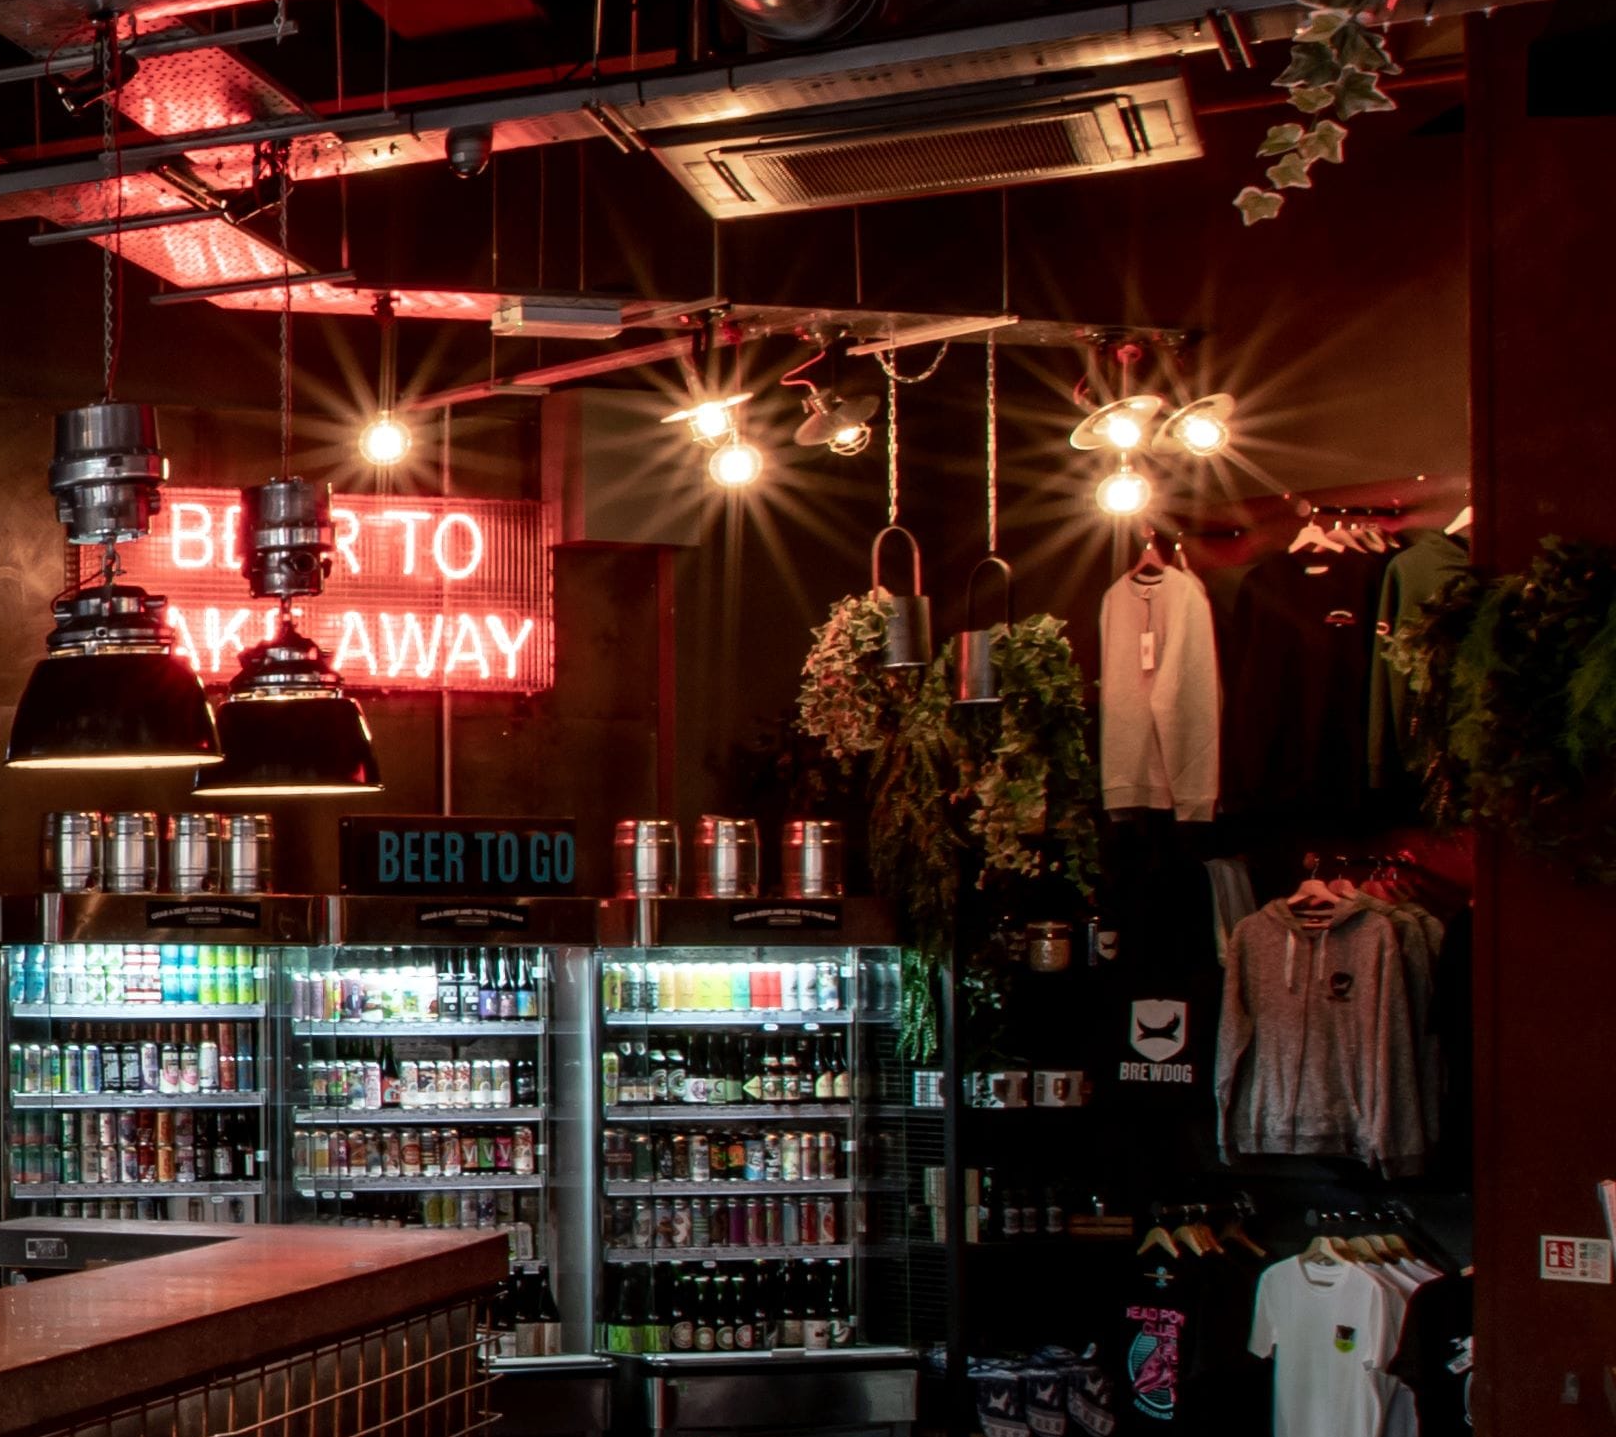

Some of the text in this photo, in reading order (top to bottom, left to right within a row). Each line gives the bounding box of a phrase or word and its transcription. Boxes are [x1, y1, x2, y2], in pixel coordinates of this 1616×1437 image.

[382, 509, 483, 580] TO
[333, 611, 533, 680] AWAY
[379, 830, 575, 884] BEER TO GO
[1120, 1061, 1192, 1083] BREWDOG
